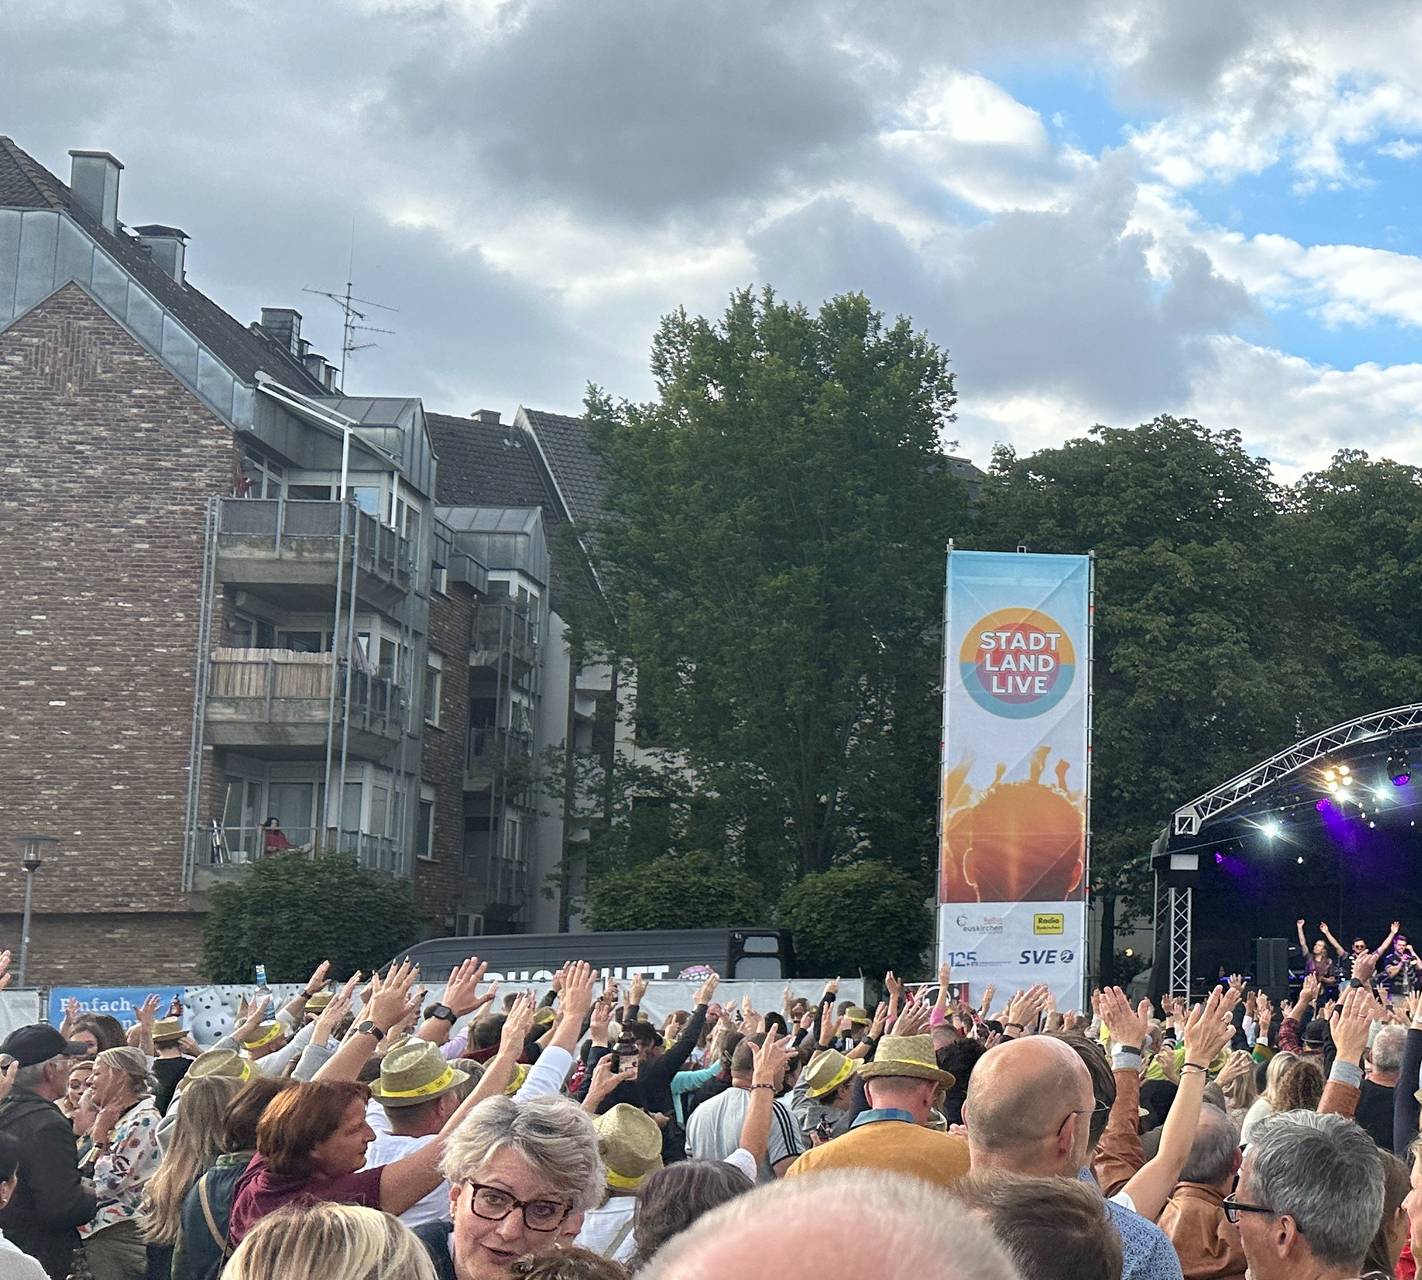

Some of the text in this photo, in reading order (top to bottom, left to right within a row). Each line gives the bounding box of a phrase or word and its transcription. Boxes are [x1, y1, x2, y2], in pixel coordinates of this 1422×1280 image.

[979, 631, 1061, 651] STADT
[985, 653, 1055, 673] LAND
[992, 676, 1049, 694] LIVE
[1038, 917, 1060, 925] Radio
[1019, 950, 1057, 965] SVE
